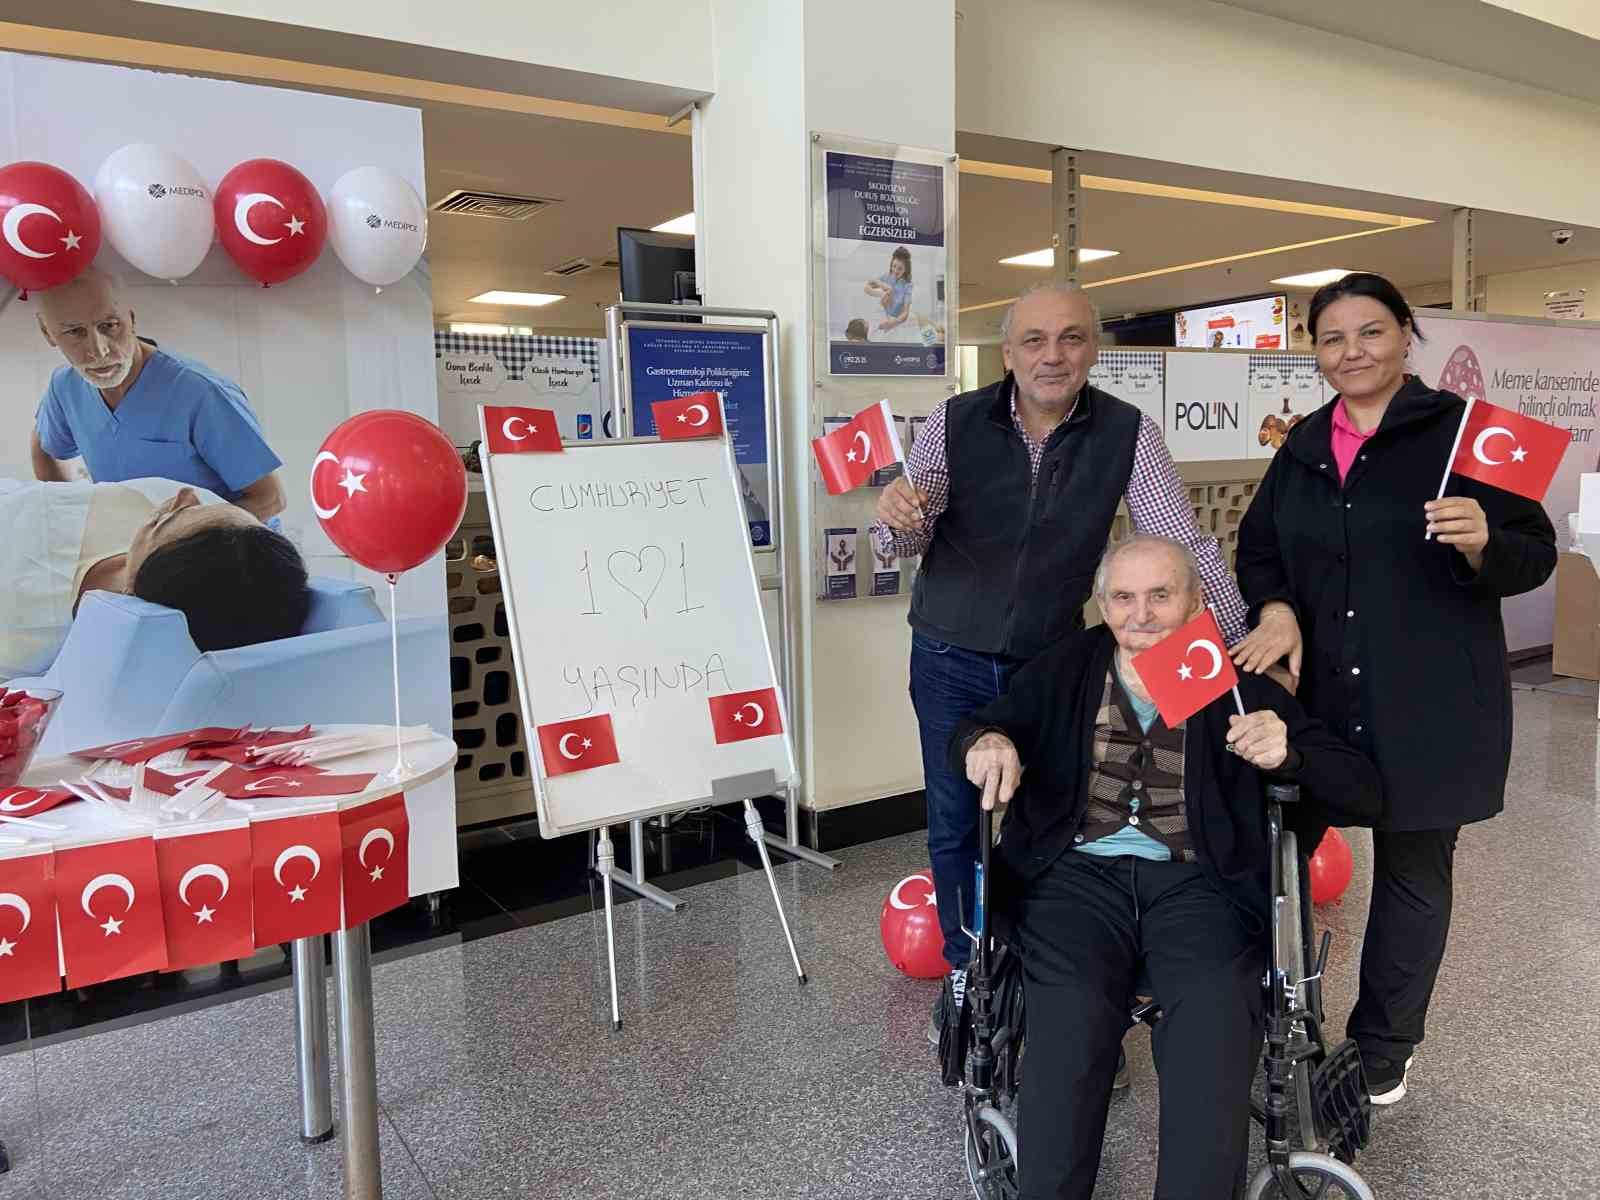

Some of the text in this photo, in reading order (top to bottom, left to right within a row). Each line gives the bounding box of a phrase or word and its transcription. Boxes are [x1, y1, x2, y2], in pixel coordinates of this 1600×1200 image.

[866, 214, 910, 227] SCHROTH
[859, 225, 916, 239] EGZERSİZLERİ
[552, 367, 584, 378] Hamburger
[646, 366, 705, 379] Gastroenteroloji
[667, 378, 694, 387] Uzman
[695, 378, 723, 387] Kadrosu
[1491, 368, 1600, 392] Meme kanserinde
[1518, 394, 1596, 421] bilinçli olmak
